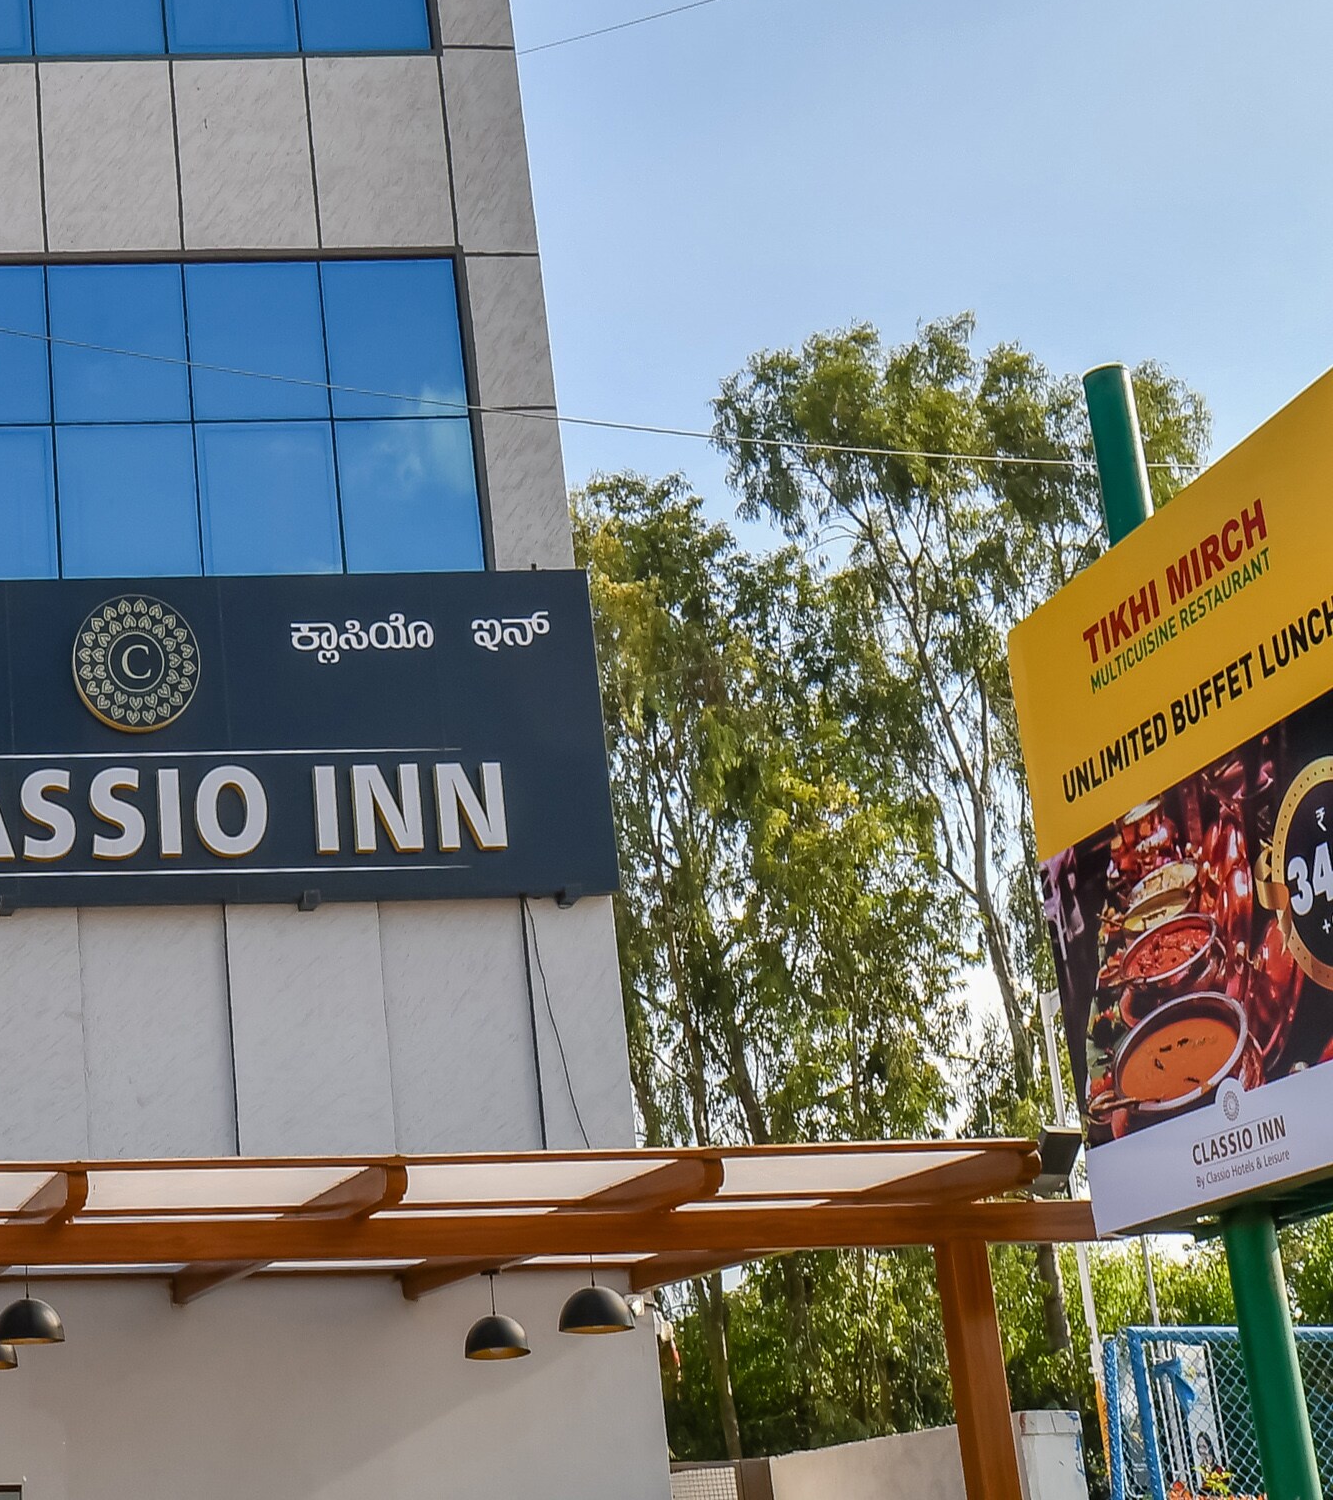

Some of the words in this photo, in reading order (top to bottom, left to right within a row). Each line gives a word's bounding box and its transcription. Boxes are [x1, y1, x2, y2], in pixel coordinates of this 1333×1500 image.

[1083, 579, 1160, 664] TIKHI
[1166, 498, 1268, 605] MIRCH
[471, 610, 550, 651] ಇನ್
[1090, 616, 1178, 694] MULTICUISINE
[1179, 547, 1270, 631] RESTAURANT
[121, 644, 152, 679] C
[1062, 711, 1168, 803] UNLIMITED
[1170, 651, 1252, 736] BUFFET
[312, 761, 509, 855] INN
[1192, 1127, 1253, 1166] CLASSIO
[1257, 1115, 1287, 1146] INN
[1196, 1176, 1206, 1189] By
[1206, 1167, 1231, 1184] Classio
[1231, 1160, 1255, 1177] Hotels
[1256, 1155, 1263, 1171] &
[1263, 1149, 1291, 1167] Leisure
